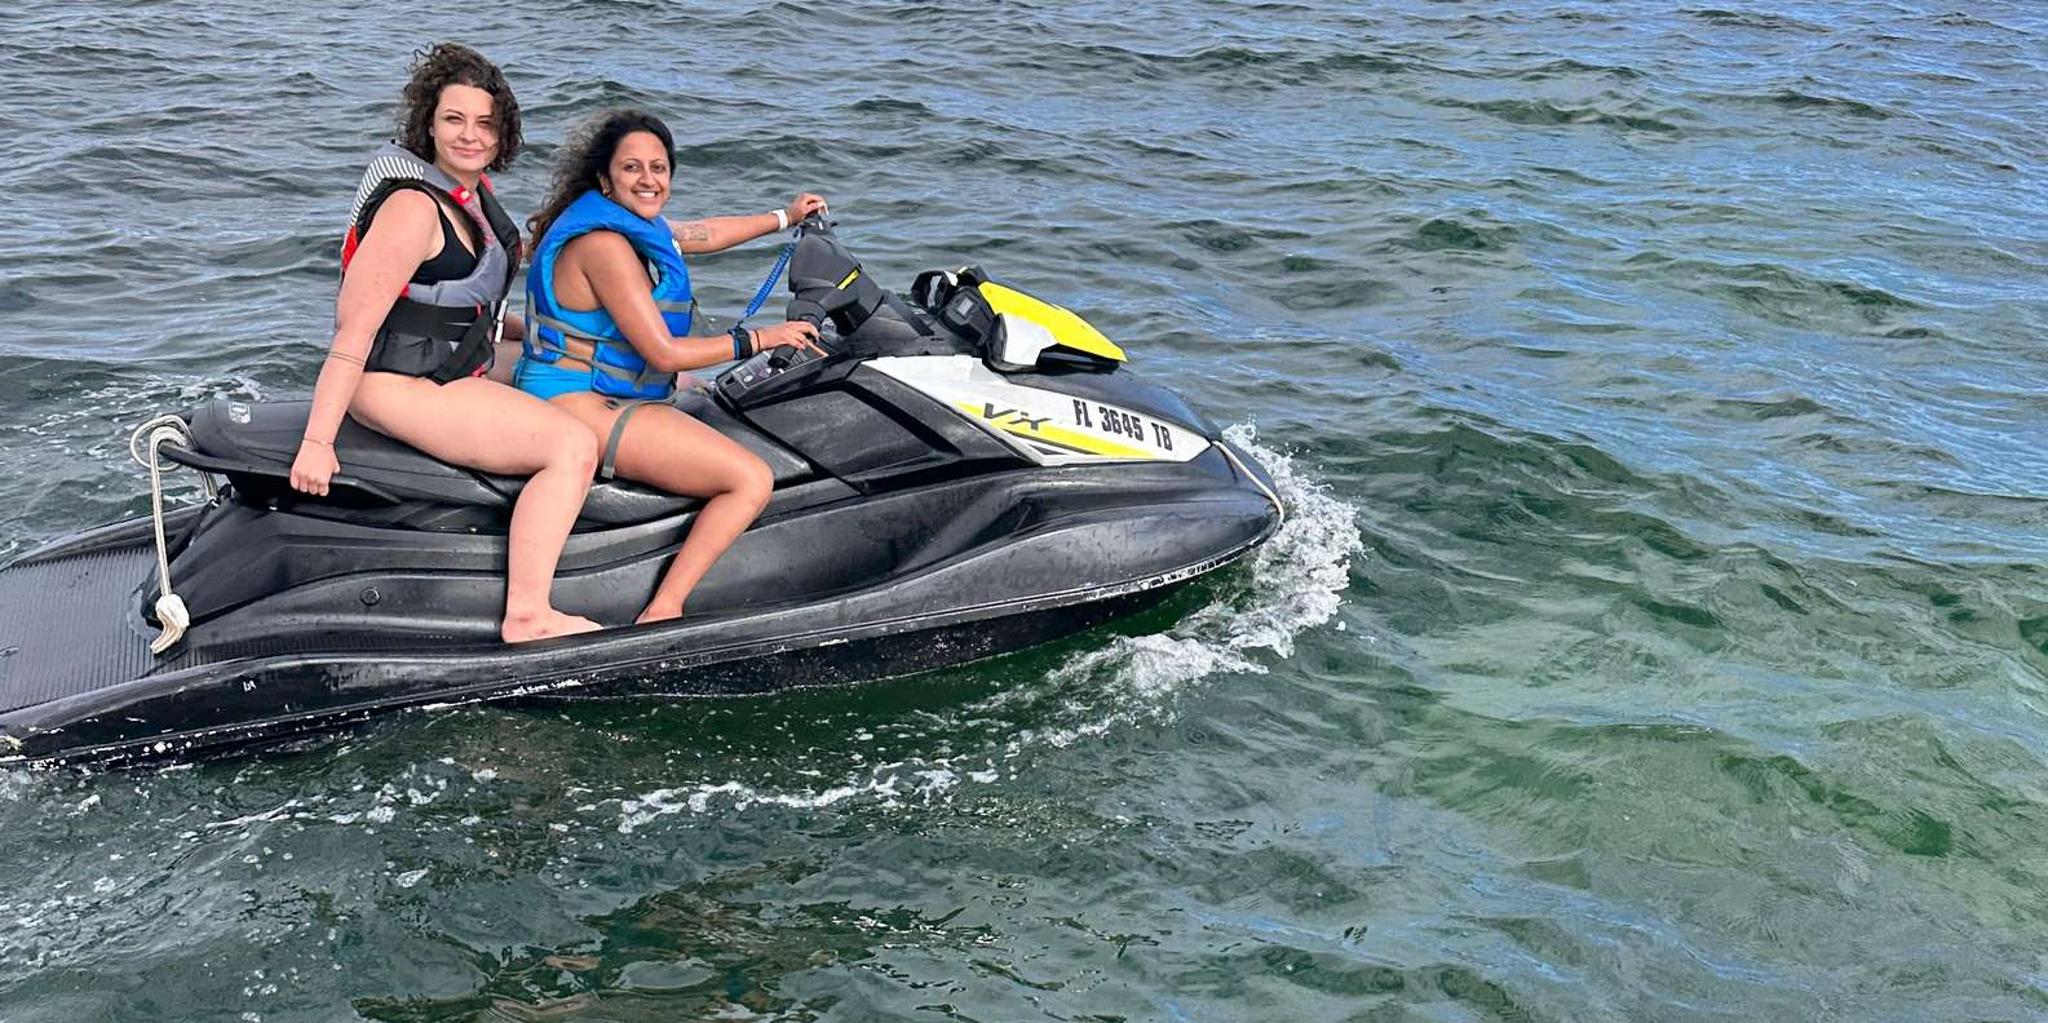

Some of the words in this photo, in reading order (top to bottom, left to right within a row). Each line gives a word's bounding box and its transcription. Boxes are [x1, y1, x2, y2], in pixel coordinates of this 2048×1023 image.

[1073, 399, 1093, 428] FL
[1099, 406, 1144, 442] 3645
[1151, 422, 1173, 451] TB
